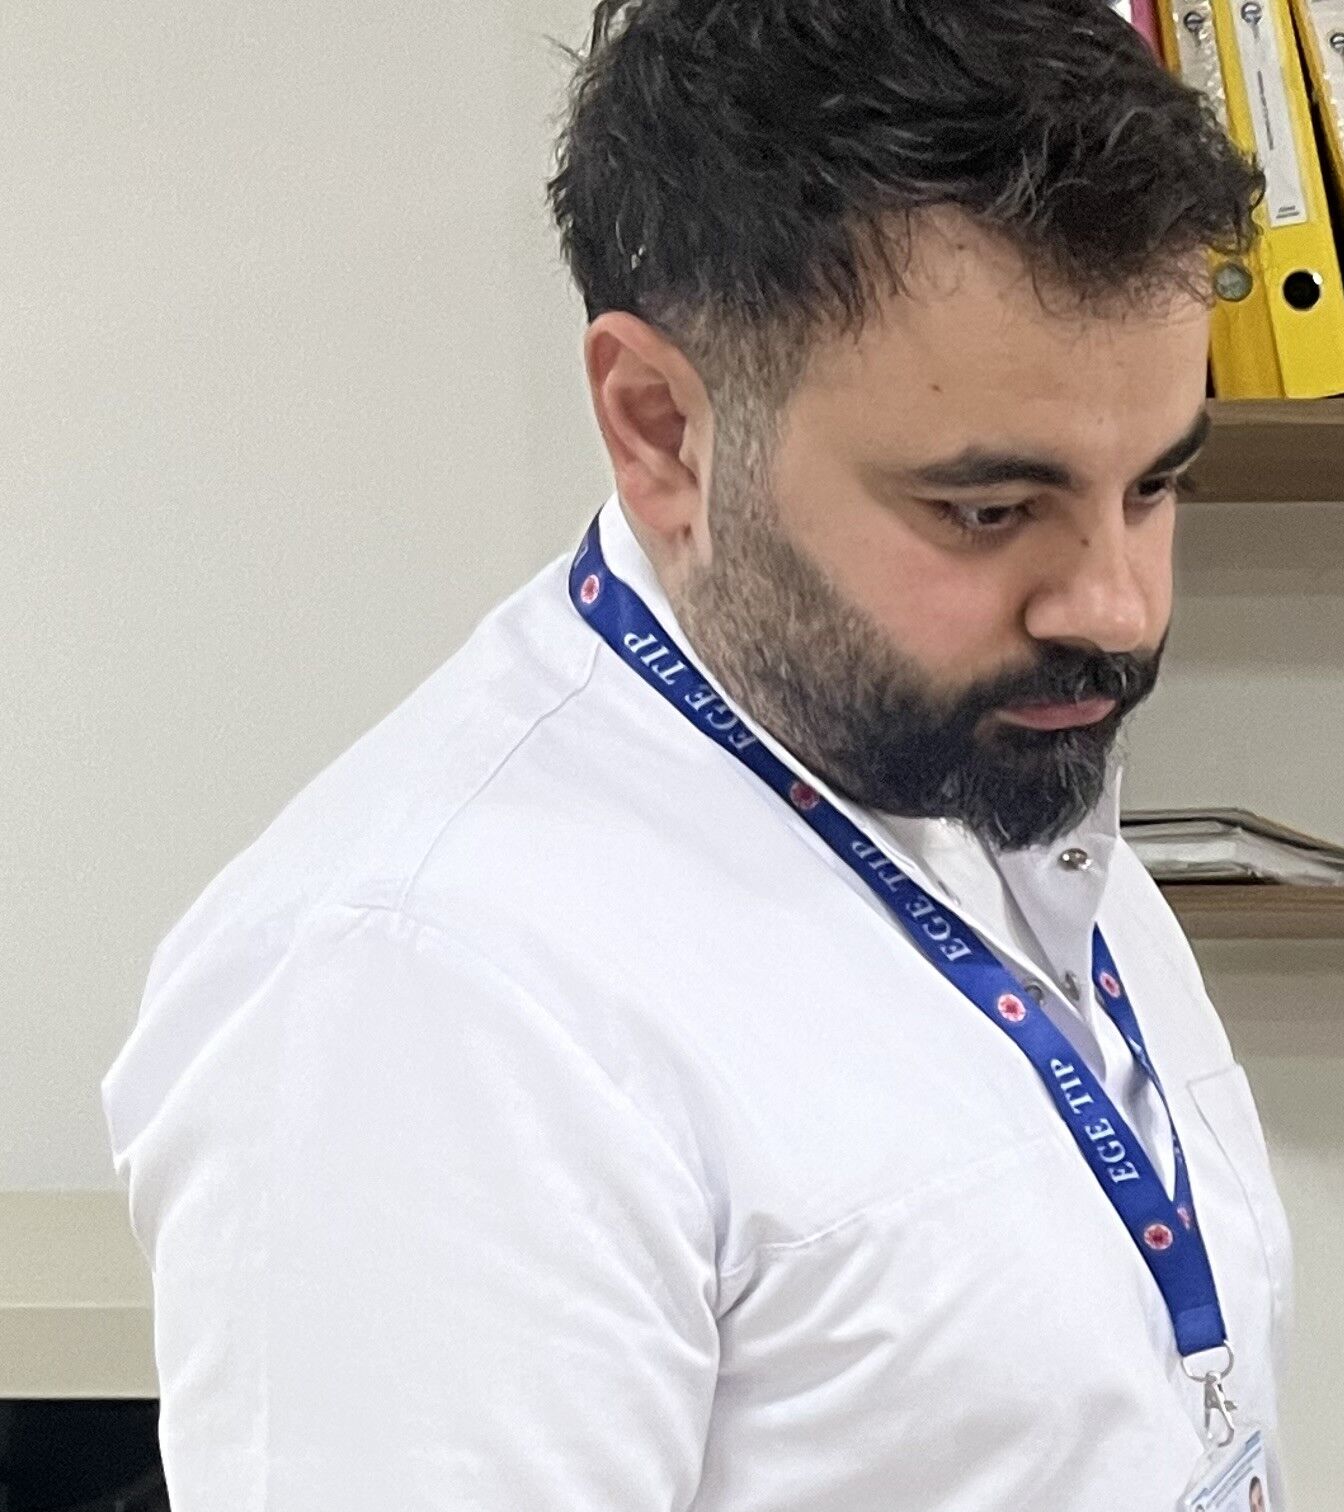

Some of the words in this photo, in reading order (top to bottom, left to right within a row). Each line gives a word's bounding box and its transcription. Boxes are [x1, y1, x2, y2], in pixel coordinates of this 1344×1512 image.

[623, 632, 688, 686] TIP
[684, 683, 757, 750] EGE
[850, 840, 909, 893] TIP
[905, 894, 972, 961] EGE
[1050, 1058, 1094, 1115] TIP
[1084, 1117, 1140, 1183] EGE
